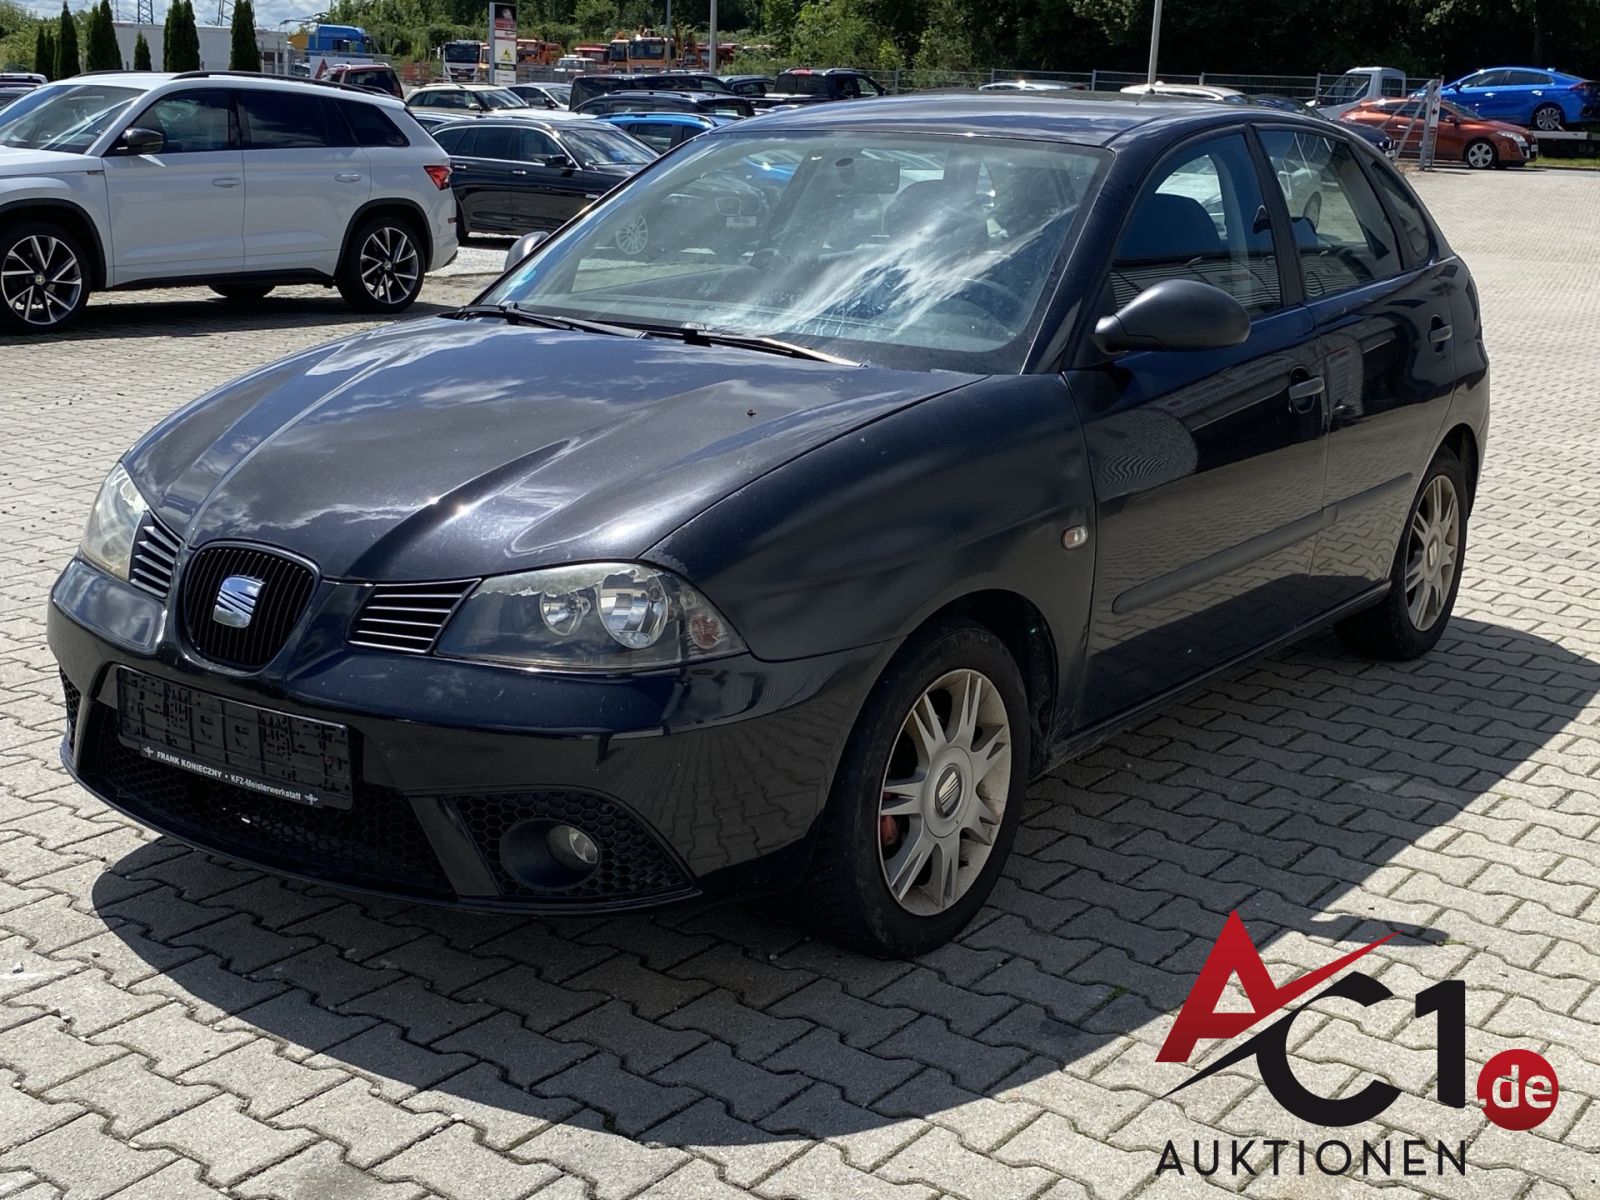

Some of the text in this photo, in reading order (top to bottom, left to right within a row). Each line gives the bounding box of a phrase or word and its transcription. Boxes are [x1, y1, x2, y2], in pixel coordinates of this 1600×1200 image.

[156, 751, 301, 800] FRANK KONIECZNY KFZ-Meisterwerkstatt
